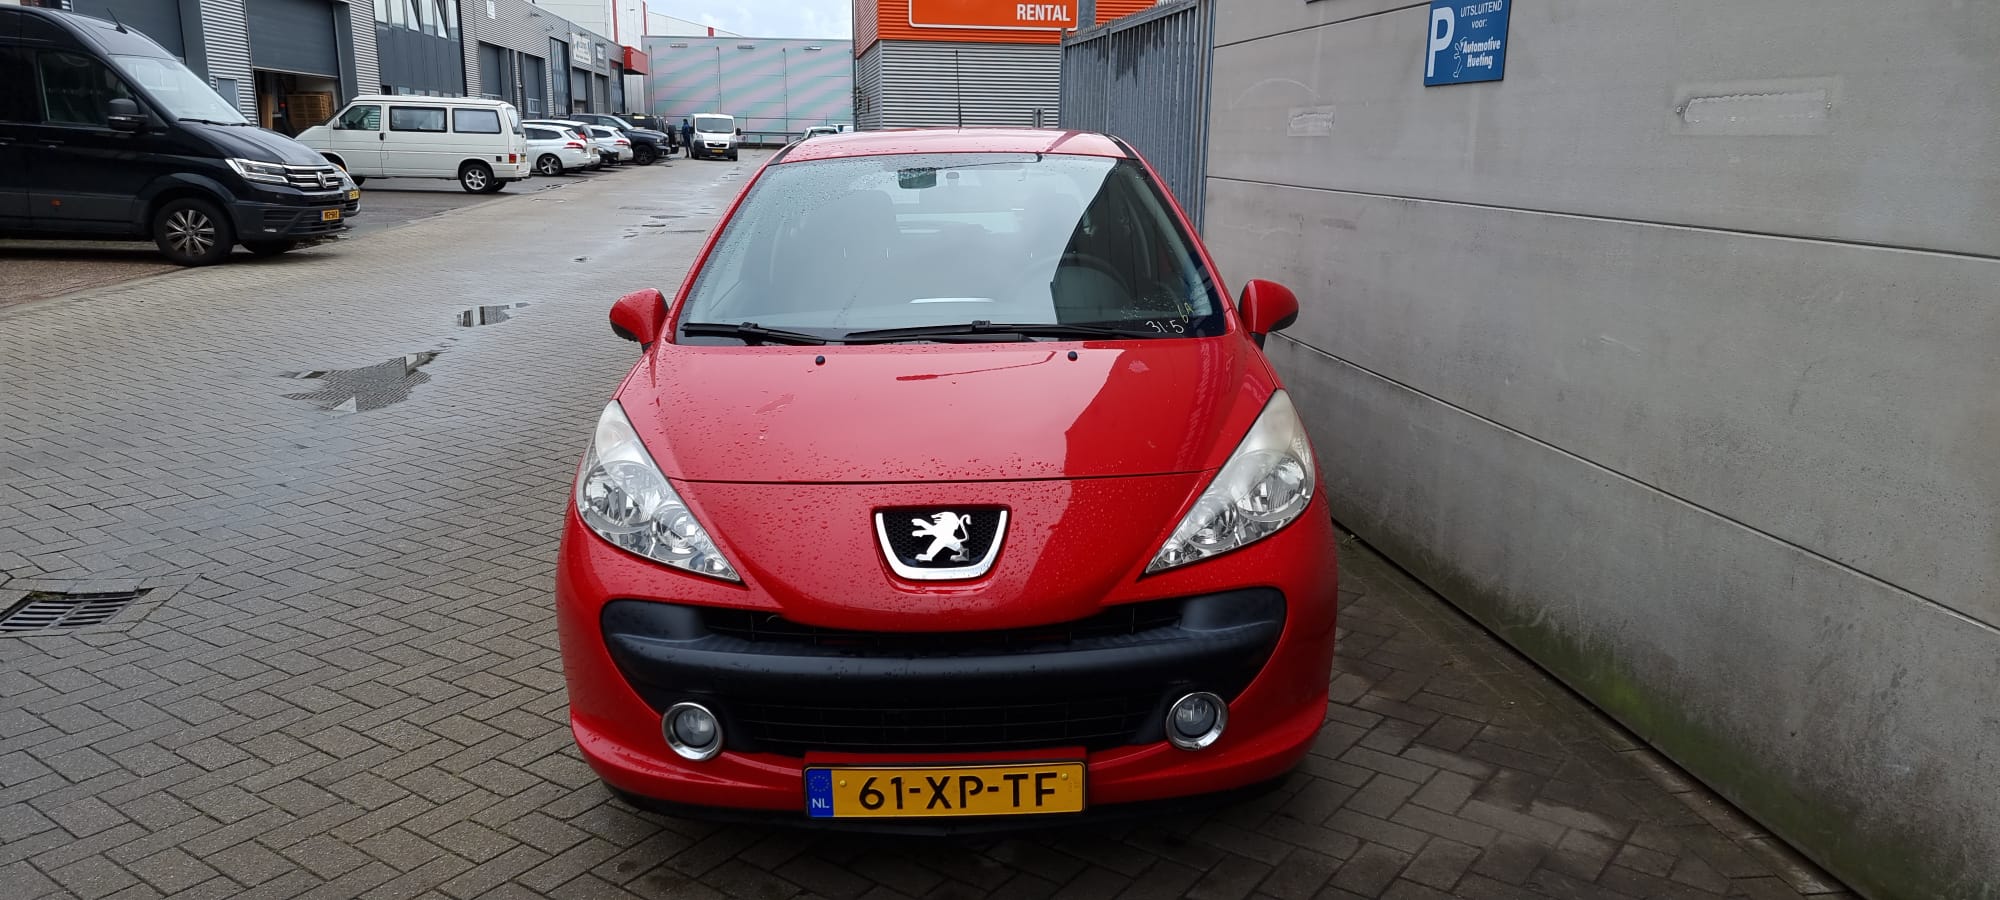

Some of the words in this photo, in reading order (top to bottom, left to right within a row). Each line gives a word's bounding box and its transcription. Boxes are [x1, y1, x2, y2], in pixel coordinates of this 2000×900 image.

[1018, 3, 1070, 21] RENTAL
[1461, 0, 1502, 17] UITSLUITEND
[1471, 18, 1488, 29] voor:
[1427, 6, 1455, 77] P
[1462, 36, 1501, 54] Automotive
[1466, 53, 1494, 70] Hueting
[858, 771, 1058, 811] 61-XP-TF
[811, 797, 830, 809] NL
